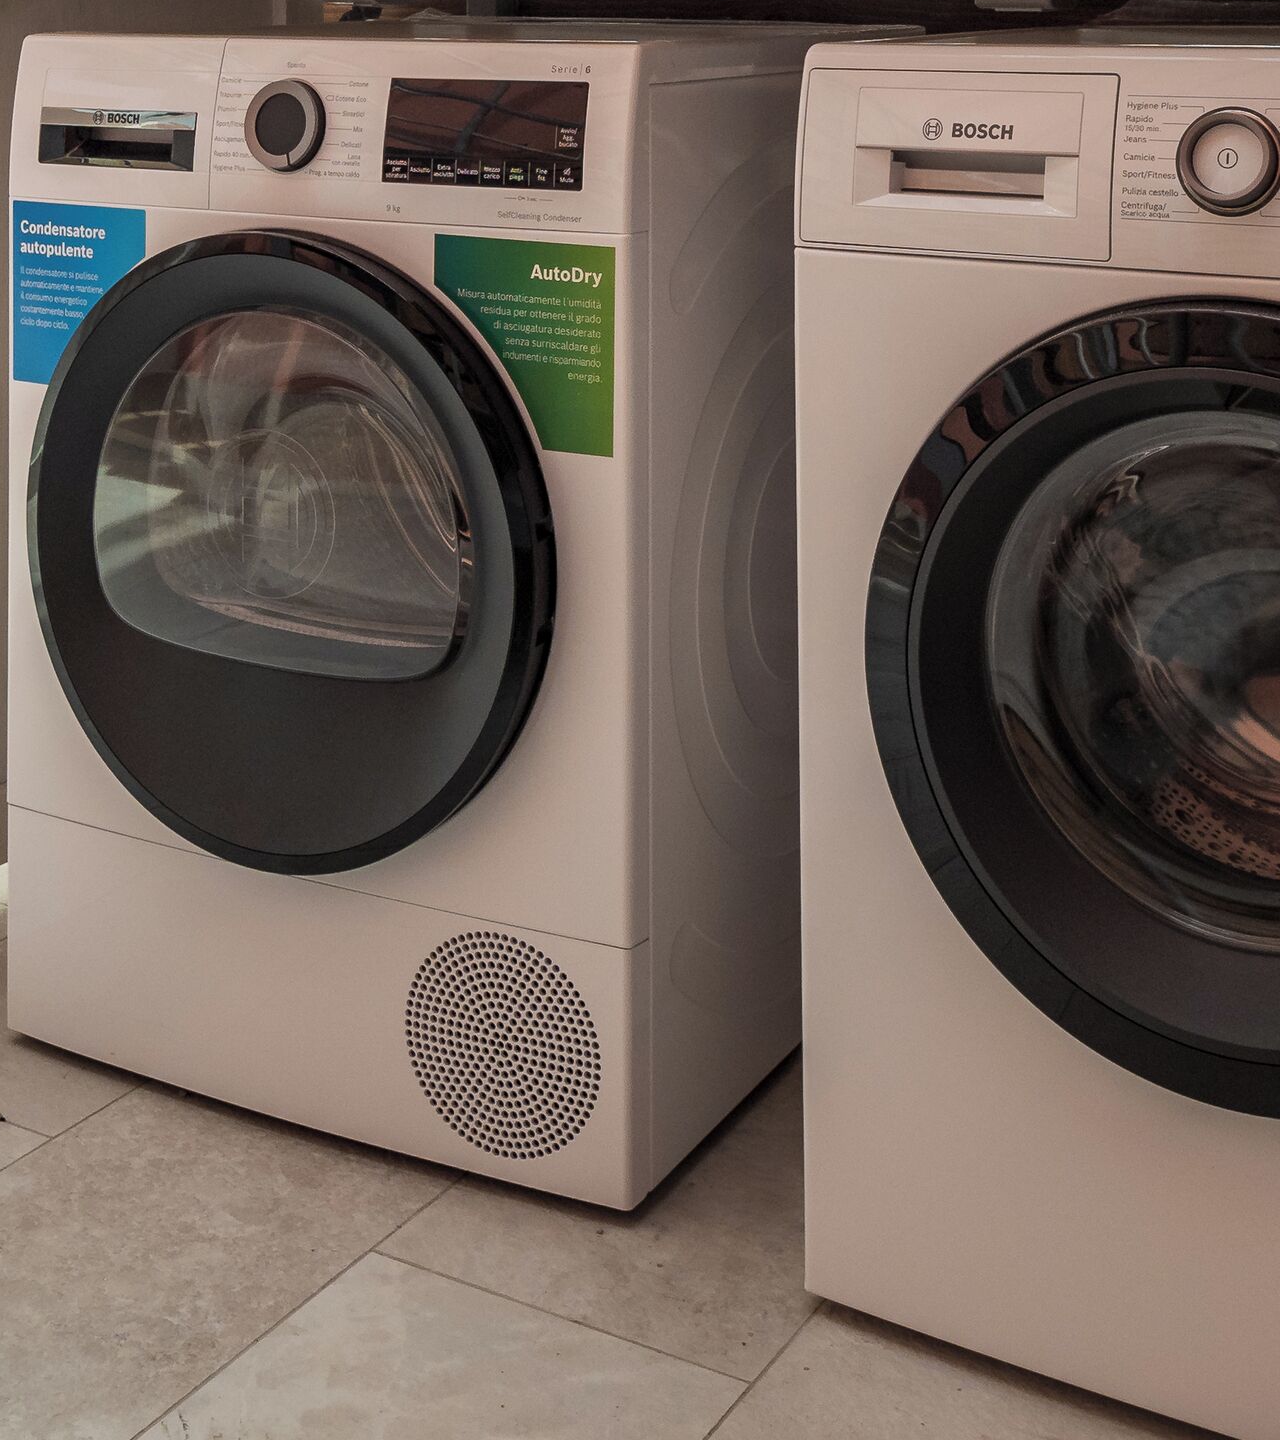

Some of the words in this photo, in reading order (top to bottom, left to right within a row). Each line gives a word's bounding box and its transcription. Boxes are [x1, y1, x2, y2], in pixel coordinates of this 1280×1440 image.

[551, 64, 578, 74] Serie
[585, 65, 592, 74] 6
[349, 80, 369, 88] Cotone
[356, 95, 367, 103] Eco
[1127, 101, 1159, 111] Hygiene
[1160, 102, 1178, 110] Plus
[107, 113, 140, 124] BOSCH
[1125, 114, 1154, 123] Rapido
[951, 122, 1014, 140] BOSCH
[1125, 124, 1145, 132] 15/30
[1123, 135, 1147, 143] Jeans
[1123, 152, 1156, 161] Camicie
[328, 170, 344, 178] tempo
[456, 168, 479, 176] Delicato
[1122, 169, 1176, 180] Sport/Fitness
[1122, 187, 1147, 195] Pulizia
[1148, 188, 1179, 197] cestello
[386, 204, 391, 212] 9
[392, 204, 401, 214] kg
[1121, 201, 1167, 212] Centrifuga/
[497, 210, 540, 223] SelfCleaning
[543, 213, 582, 223] Condenser
[1120, 209, 1147, 218] Scarico
[20, 220, 106, 240] Condensatore
[20, 242, 94, 259] autopulente
[25, 267, 67, 278] condensatore
[75, 271, 99, 281] pulisce
[530, 264, 603, 288] AutoDry
[20, 279, 70, 292] automaticamente
[25, 293, 54, 303] consumo
[54, 296, 88, 308] energetico
[457, 288, 486, 300] Misura
[487, 289, 561, 306] automaticamente
[20, 305, 64, 317] costantemente
[480, 305, 511, 316] residua
[513, 308, 528, 318] per
[529, 310, 566, 321] ottenere
[568, 311, 575, 322] il
[576, 313, 602, 326] grado
[35, 318, 52, 329] dopo
[493, 320, 502, 329] di
[503, 322, 553, 335] asciugatura
[554, 326, 601, 339] desiderato
[505, 337, 530, 347] senza
[532, 338, 589, 352] surriscaldare
[590, 342, 601, 355] gli
[503, 350, 541, 362] indumenti
[542, 355, 548, 363] e
[549, 354, 602, 368] risparmiando
[567, 371, 603, 384] energia.
